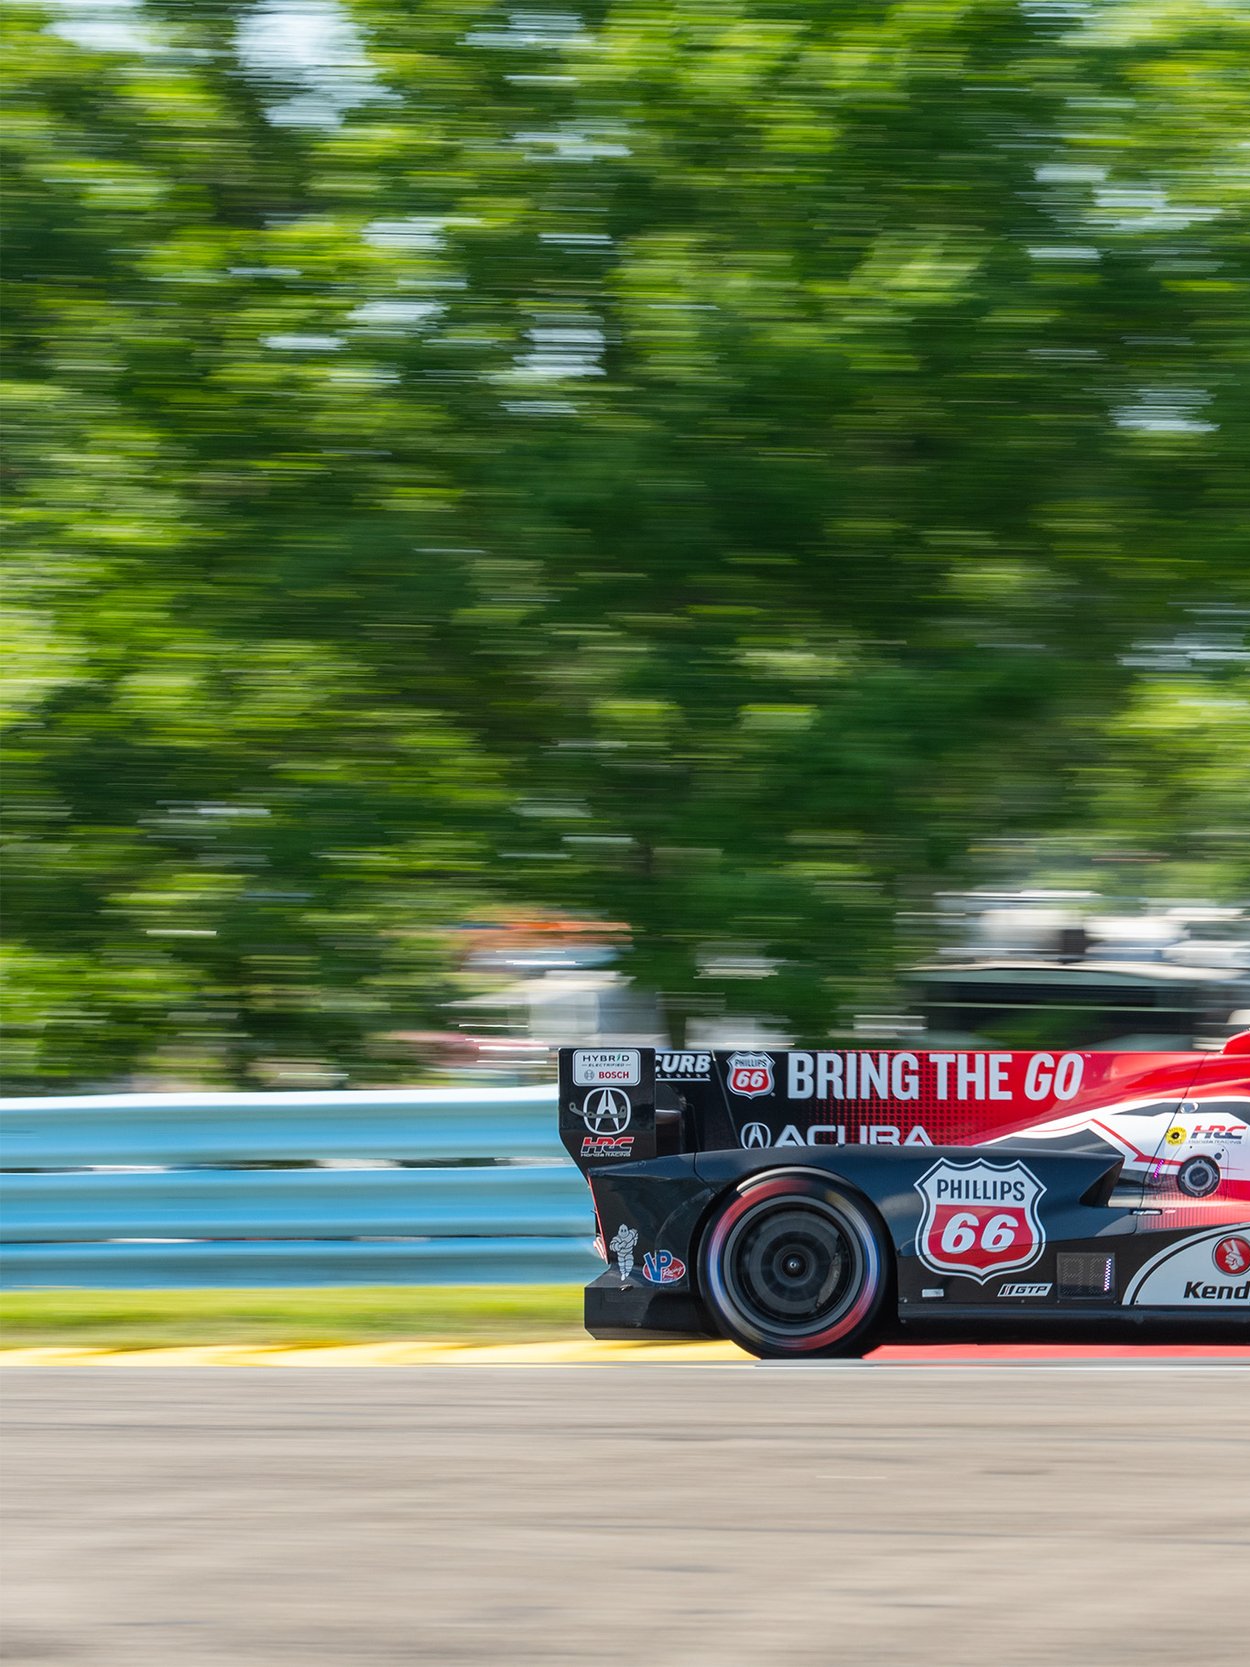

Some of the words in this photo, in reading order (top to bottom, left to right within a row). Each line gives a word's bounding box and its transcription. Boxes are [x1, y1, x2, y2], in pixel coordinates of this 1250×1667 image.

[583, 1053, 630, 1062] HYBRID
[735, 1059, 767, 1067] PHILLIPS
[599, 1071, 630, 1079] BOSCH
[736, 1070, 765, 1088] 66
[788, 1053, 919, 1100] BRING
[928, 1053, 1012, 1100] THE
[1024, 1053, 1084, 1100] GO
[774, 1125, 934, 1146] ACURA
[1190, 1125, 1247, 1139] HRC
[581, 1137, 635, 1154] HRC
[937, 1178, 1026, 1201] PHILLIPS
[941, 1212, 1019, 1254] 66
[644, 1250, 673, 1283] VP
[1015, 1285, 1047, 1294] GTP
